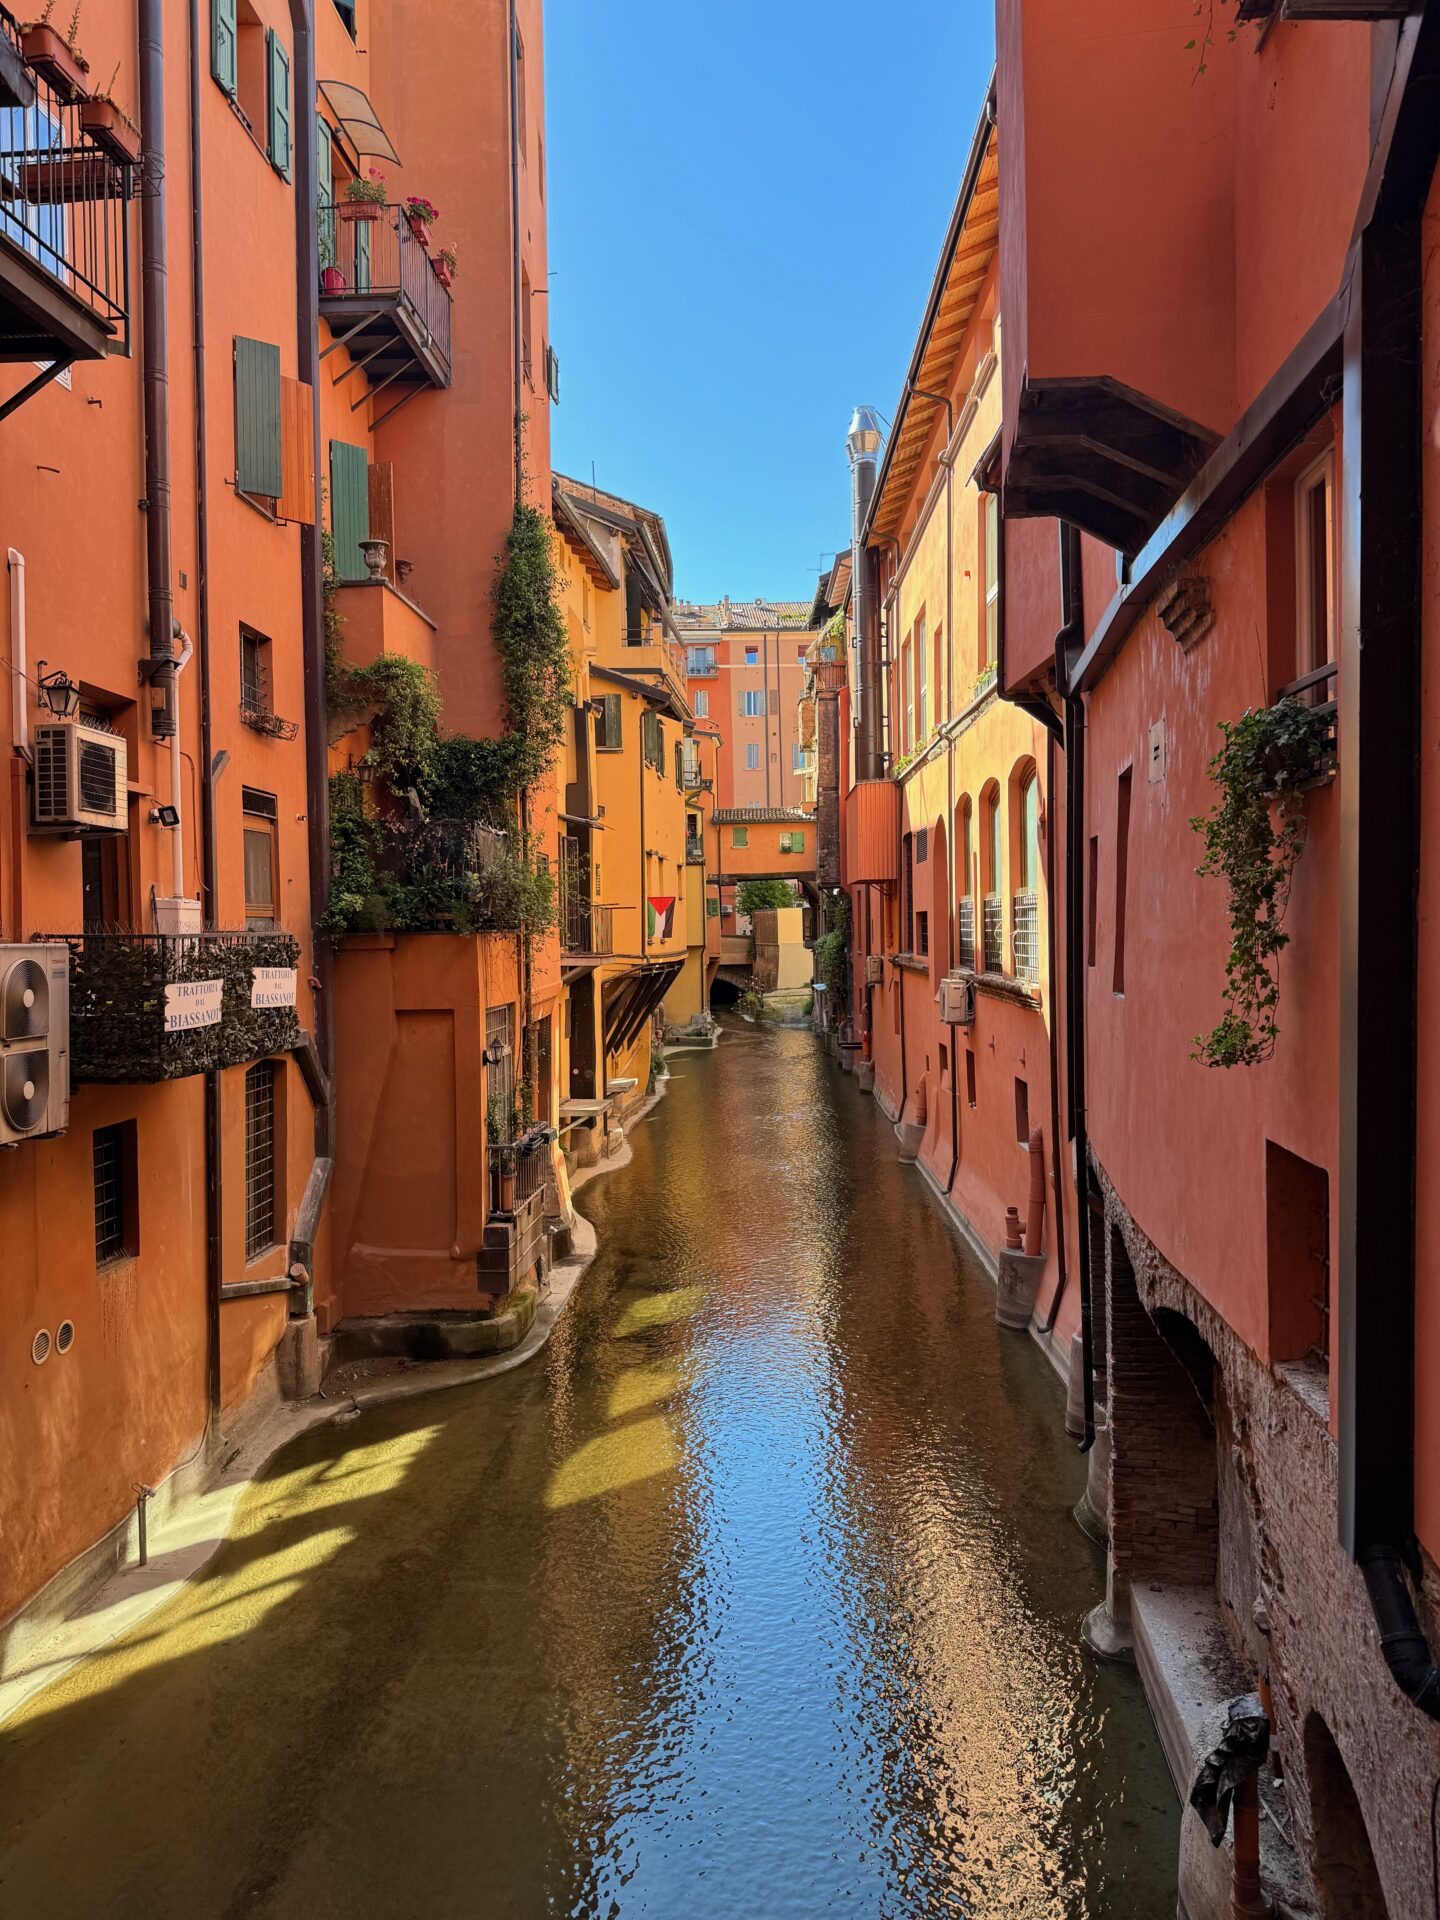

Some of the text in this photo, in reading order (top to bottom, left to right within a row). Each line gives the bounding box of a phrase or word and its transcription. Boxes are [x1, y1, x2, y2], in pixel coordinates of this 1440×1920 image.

[261, 970, 293, 980] TRATTORIA
[177, 983, 218, 997] TRATTORIA
[194, 998, 206, 1006] DAL
[256, 993, 295, 1005] BIASSANOT
[170, 1008, 221, 1029] BIASSANOT
